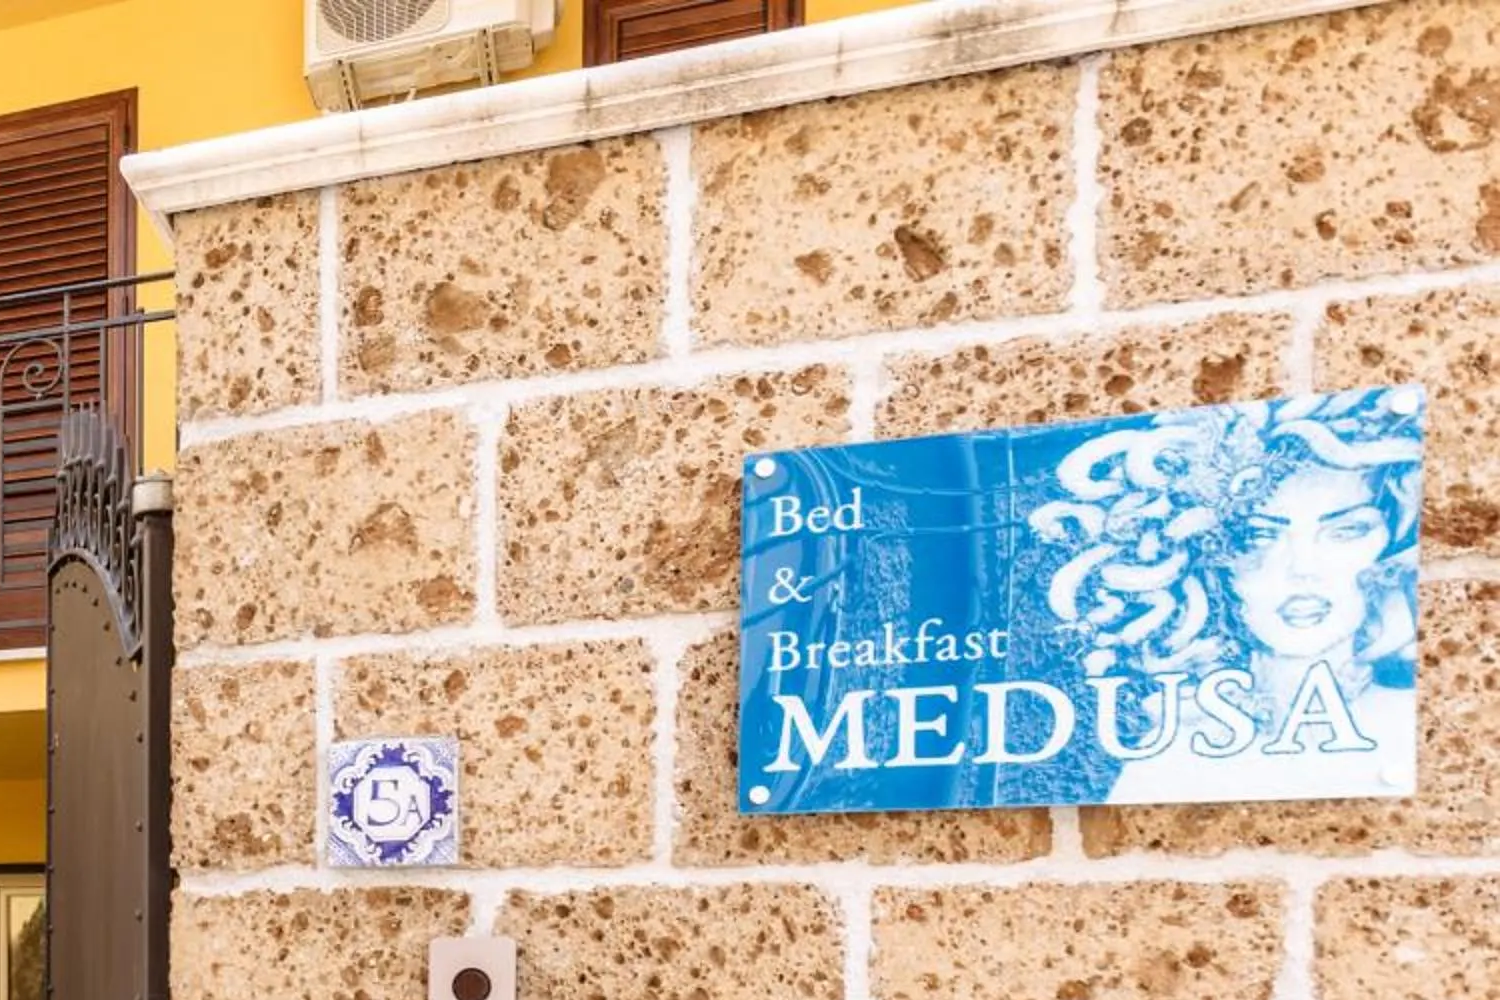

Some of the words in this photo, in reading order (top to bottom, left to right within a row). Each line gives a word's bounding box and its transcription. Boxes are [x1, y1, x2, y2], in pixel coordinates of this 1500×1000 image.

[770, 486, 864, 537] Bed
[768, 567, 813, 605] &
[767, 618, 1009, 672] Breakfast
[762, 659, 1378, 773] MEDUSA
